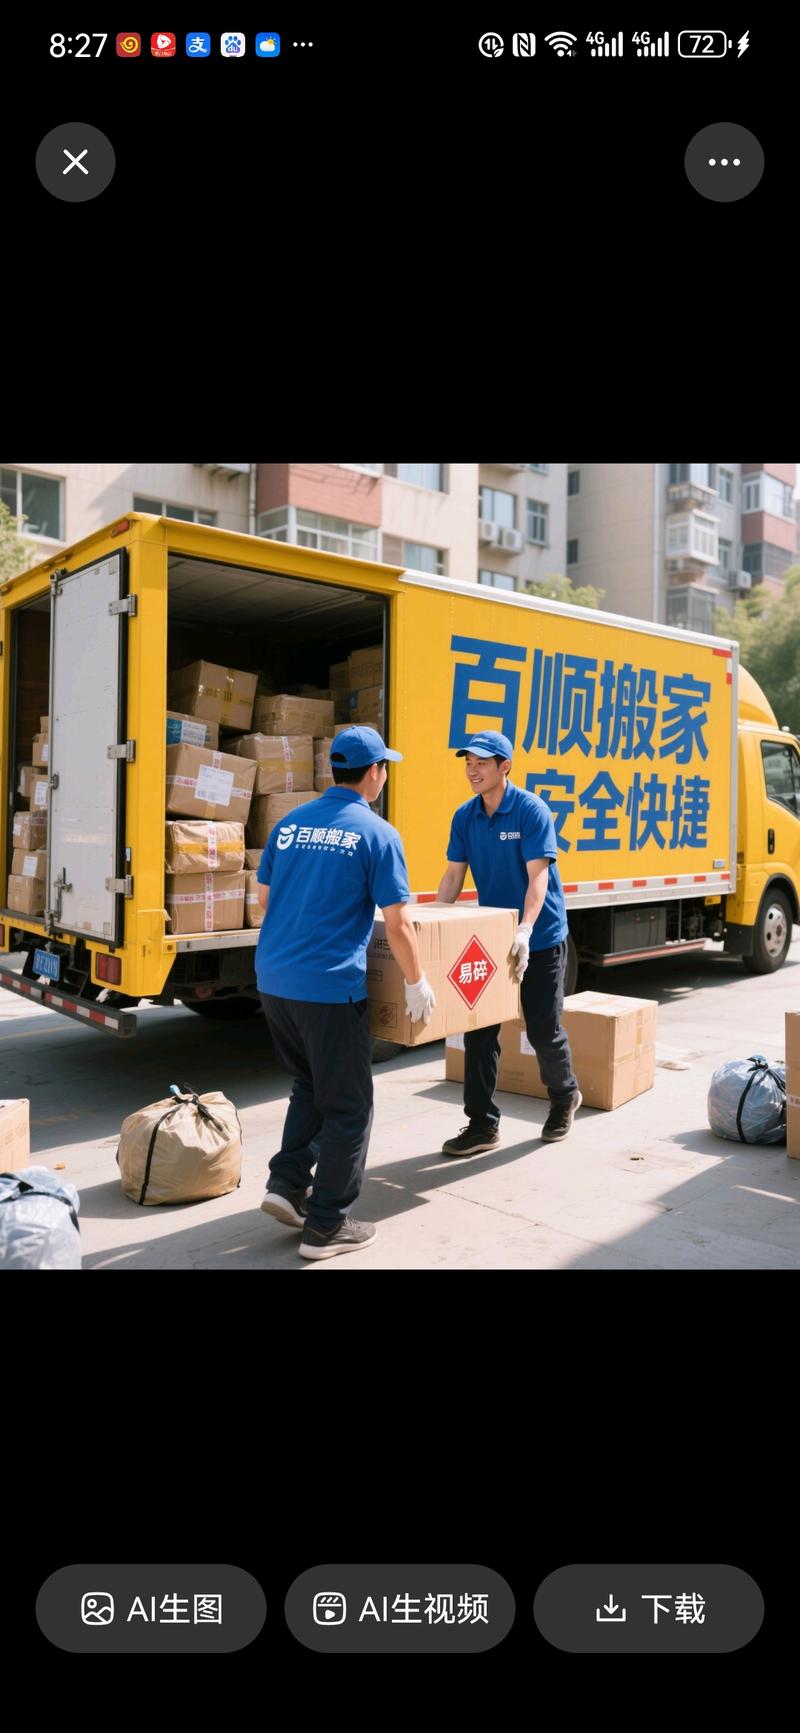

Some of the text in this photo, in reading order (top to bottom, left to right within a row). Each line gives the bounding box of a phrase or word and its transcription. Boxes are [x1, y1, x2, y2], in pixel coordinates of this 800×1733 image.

[448, 635, 711, 764] 百顺搬家
[525, 768, 710, 852] 安全快捷
[296, 826, 362, 851] 百顺搬家
[458, 959, 488, 985] 易碎
